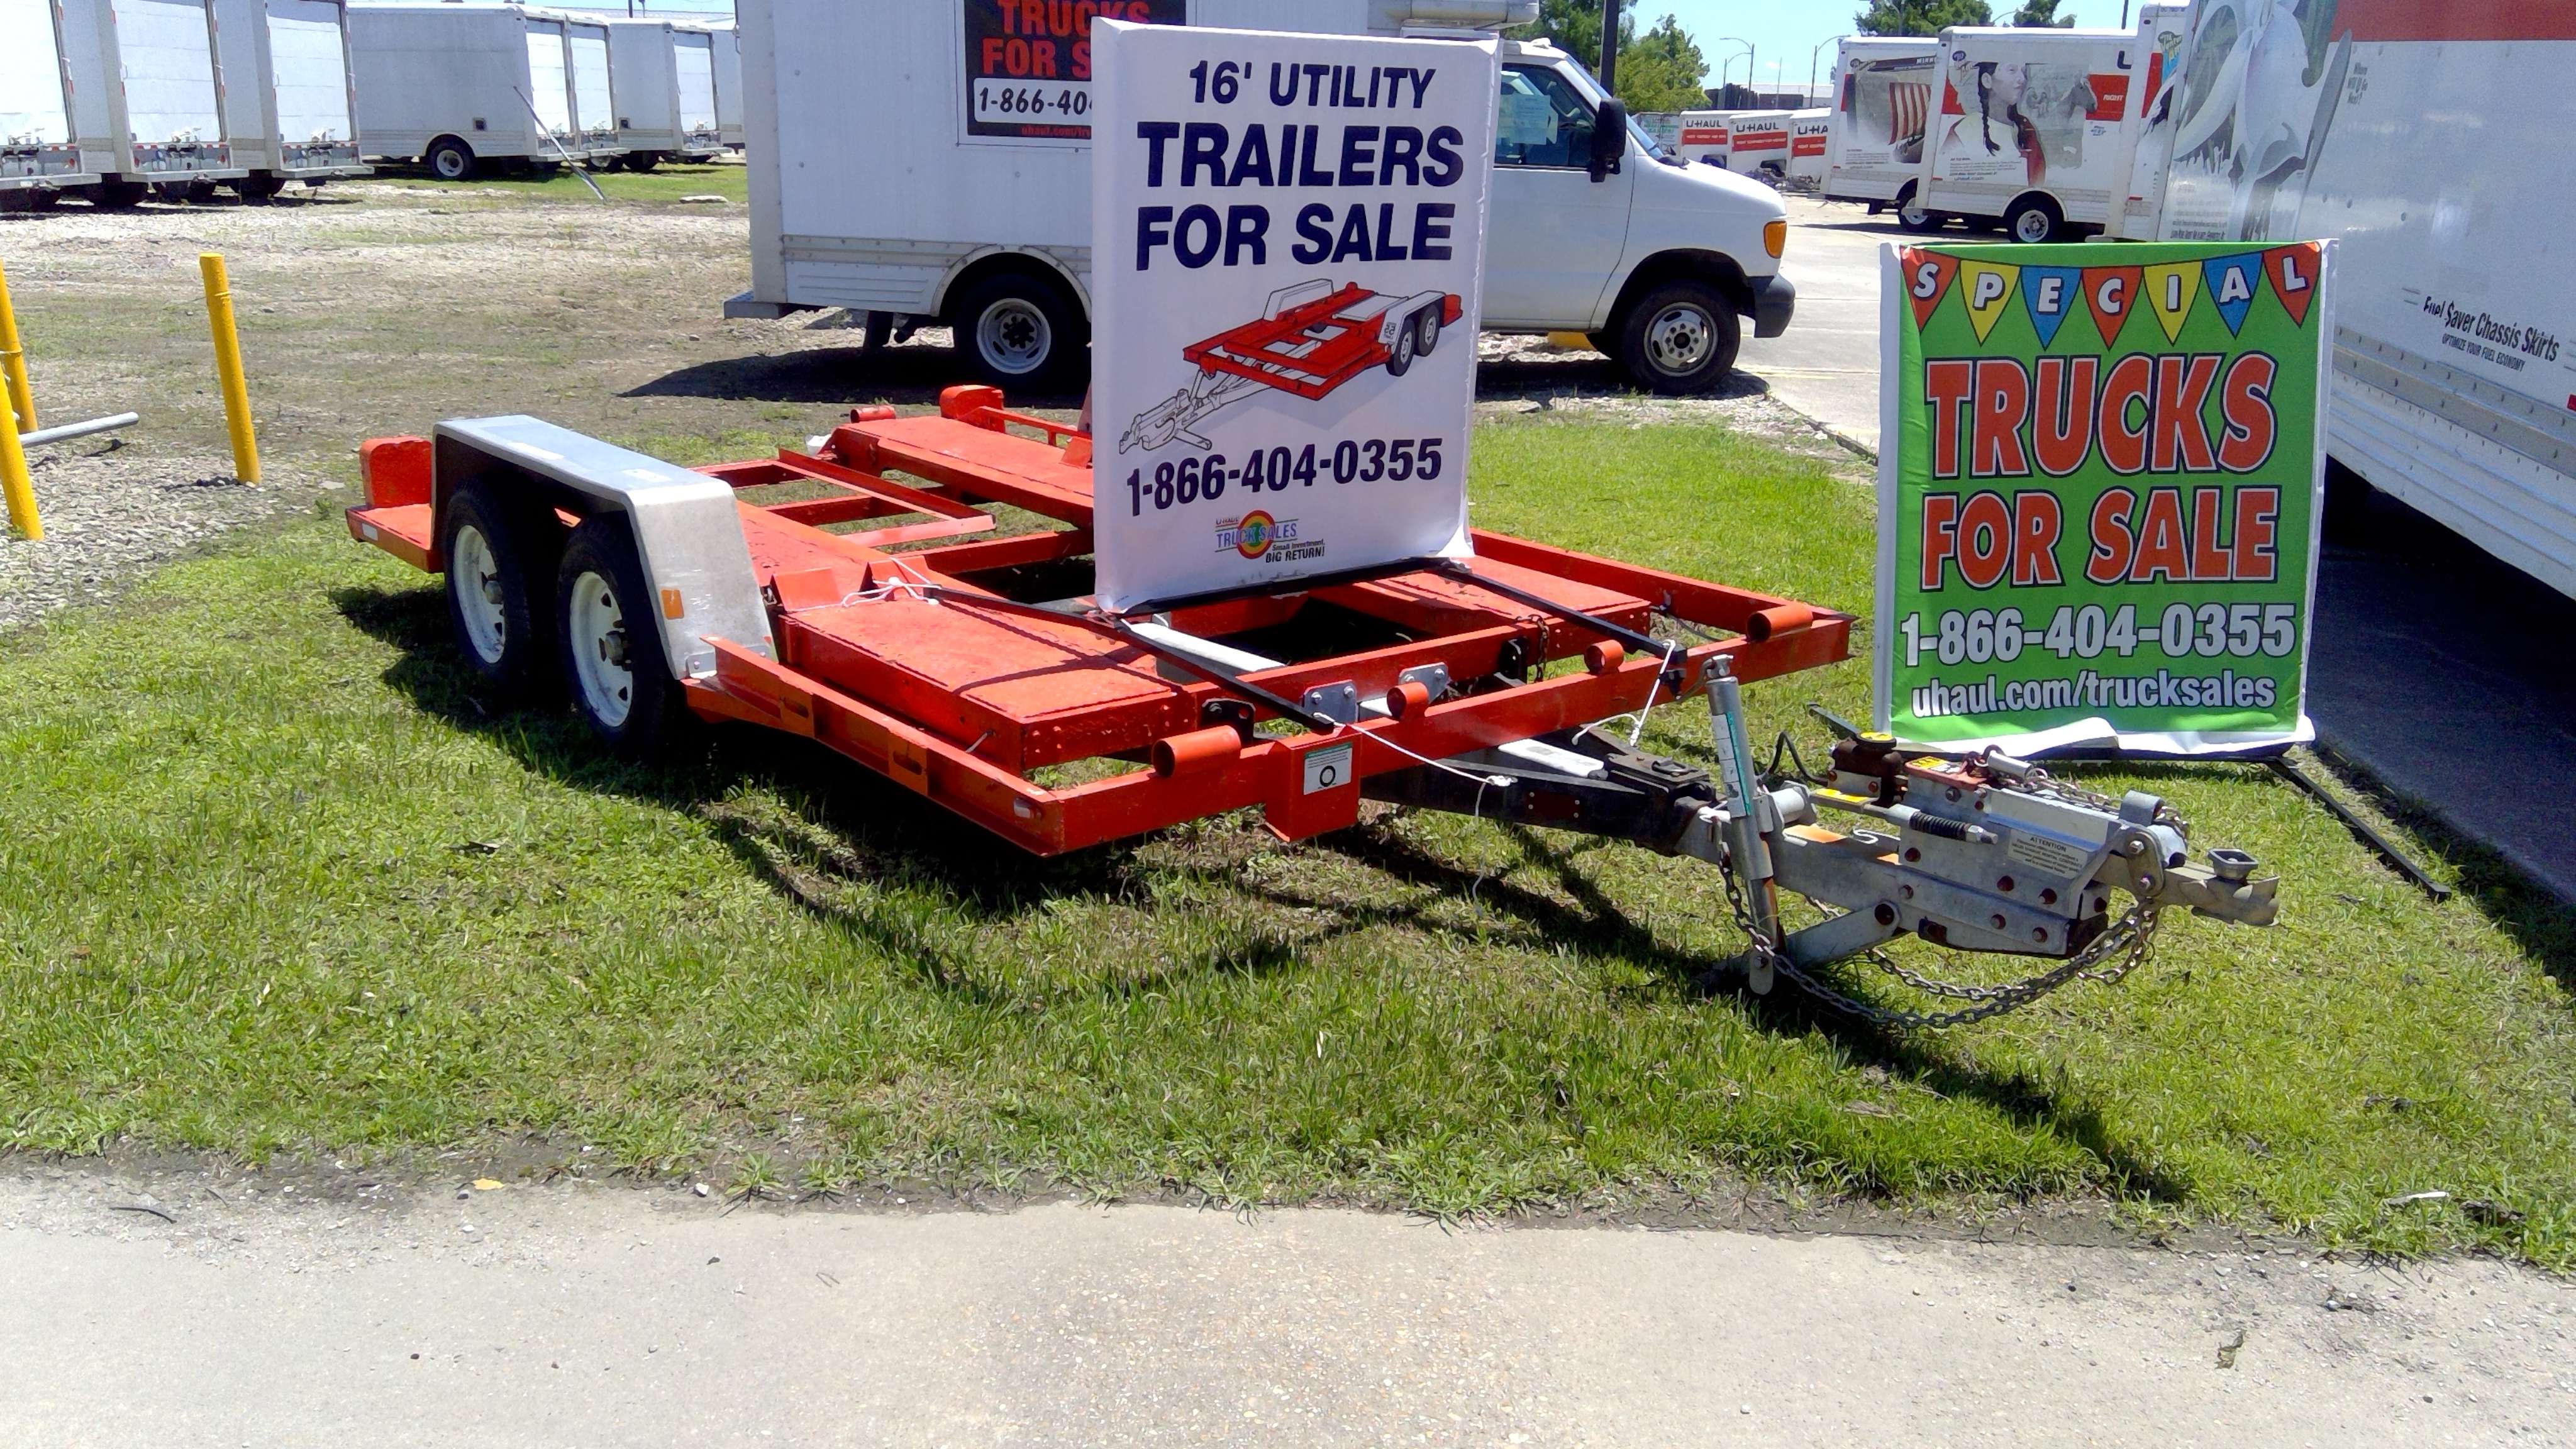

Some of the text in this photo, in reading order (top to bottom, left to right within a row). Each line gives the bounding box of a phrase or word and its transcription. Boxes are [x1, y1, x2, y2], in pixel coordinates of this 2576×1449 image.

[982, 37, 1057, 77] FOR
[980, 87, 1091, 115] 1-866-40
[1189, 60, 1436, 109] 16' UTILITY
[1137, 121, 1464, 187] TRAILERS
[1136, 203, 1456, 271] FOR SALE
[1913, 255, 2309, 314] SPECIAL
[2442, 333, 2526, 372] OPTIMIZE YOUR FUEL ECONOMY
[2475, 312, 2521, 348] Chassis
[2521, 326, 2560, 362] Skirts
[1925, 350, 2278, 480] TRUCKS
[1127, 438, 1443, 517] 1-866-404-0355
[1217, 523, 1297, 548] TRUCK SALES
[1265, 547, 1325, 563] BIG RETURN!
[1272, 543, 1290, 551] Small
[1920, 486, 2282, 592] FOR SALE
[1900, 602, 2296, 667] 1-866-404-0355
[1911, 670, 2277, 718] uhaul.com/trucksales
[2030, 837, 2067, 852] ATTENTION
